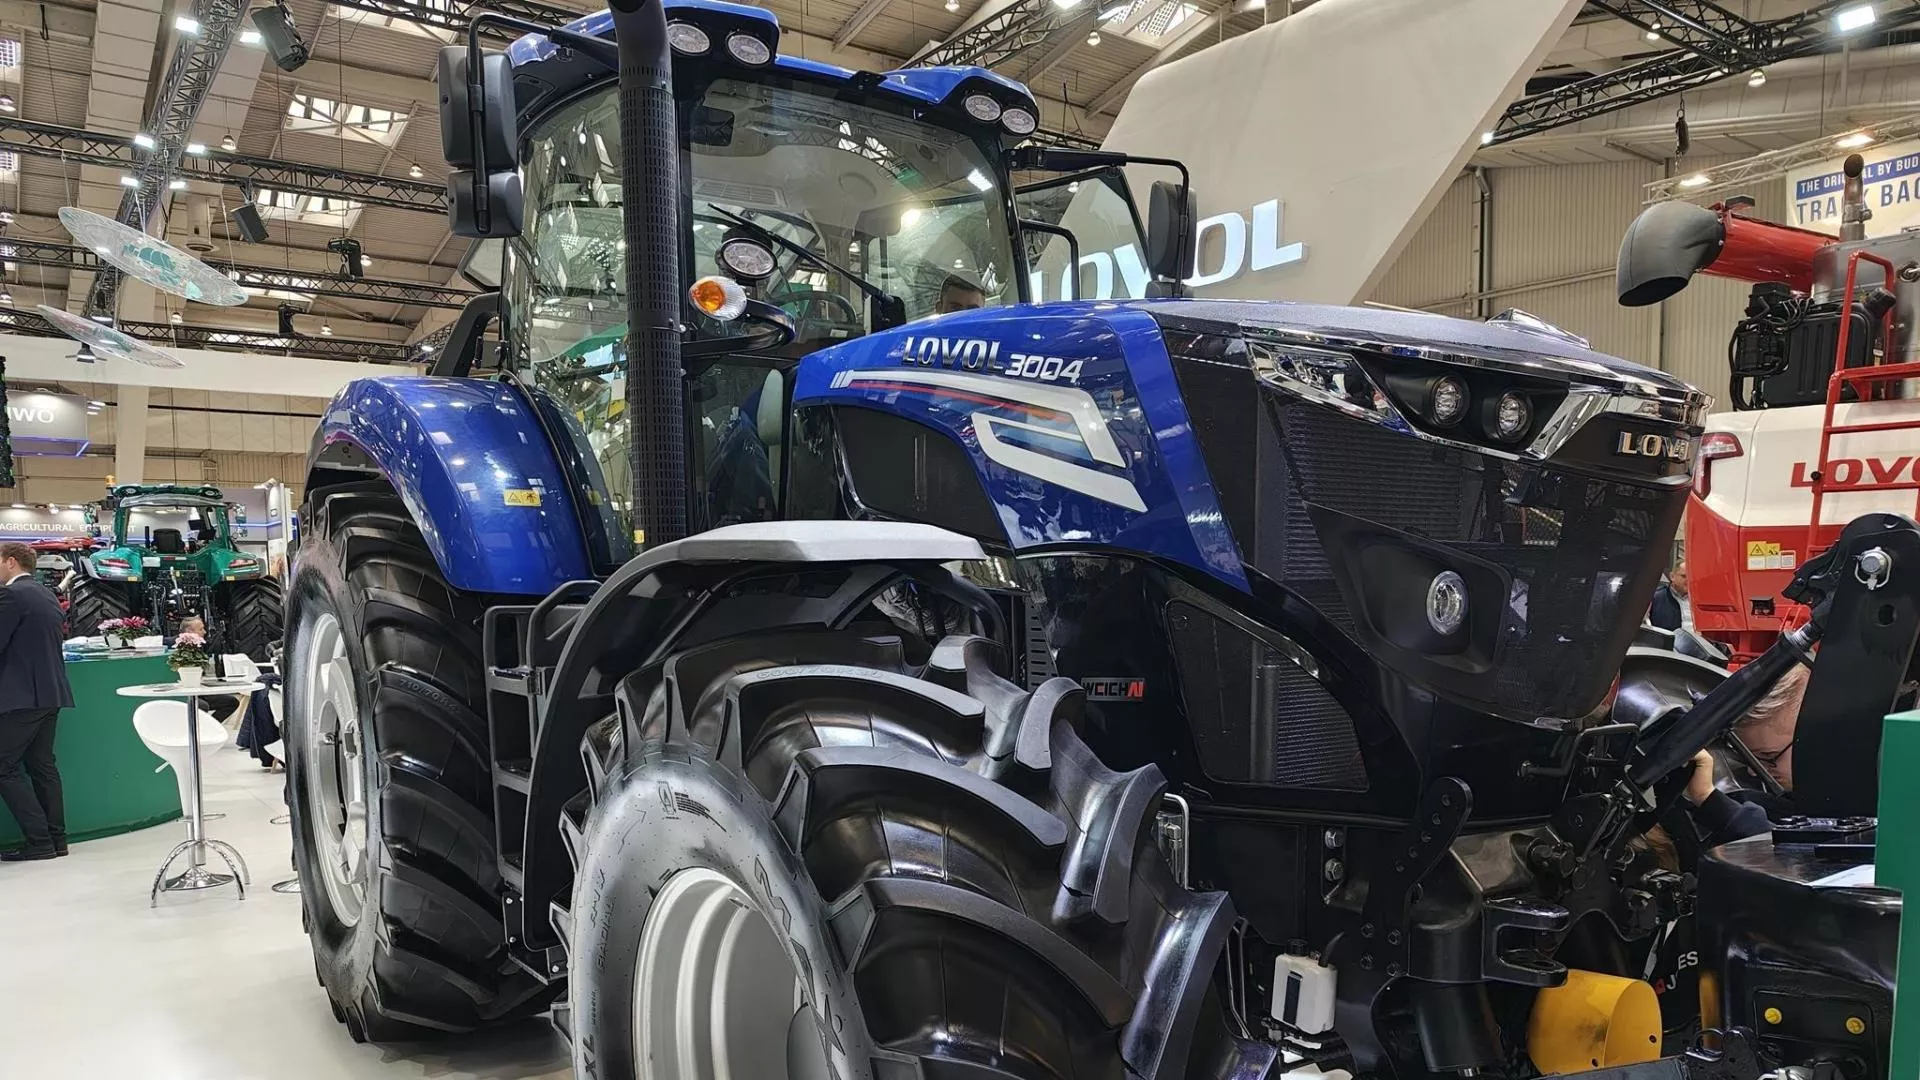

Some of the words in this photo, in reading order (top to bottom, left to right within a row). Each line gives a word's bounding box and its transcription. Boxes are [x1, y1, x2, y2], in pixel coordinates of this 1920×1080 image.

[1801, 179, 1820, 193] THE
[1824, 166, 1874, 187] ORIAL
[1877, 162, 1892, 175] BY
[902, 336, 1003, 372] LOVOL
[1005, 353, 1084, 384] 3004
[1791, 456, 1920, 487] LOV
[0, 523, 74, 532] AGRICULTURAL
